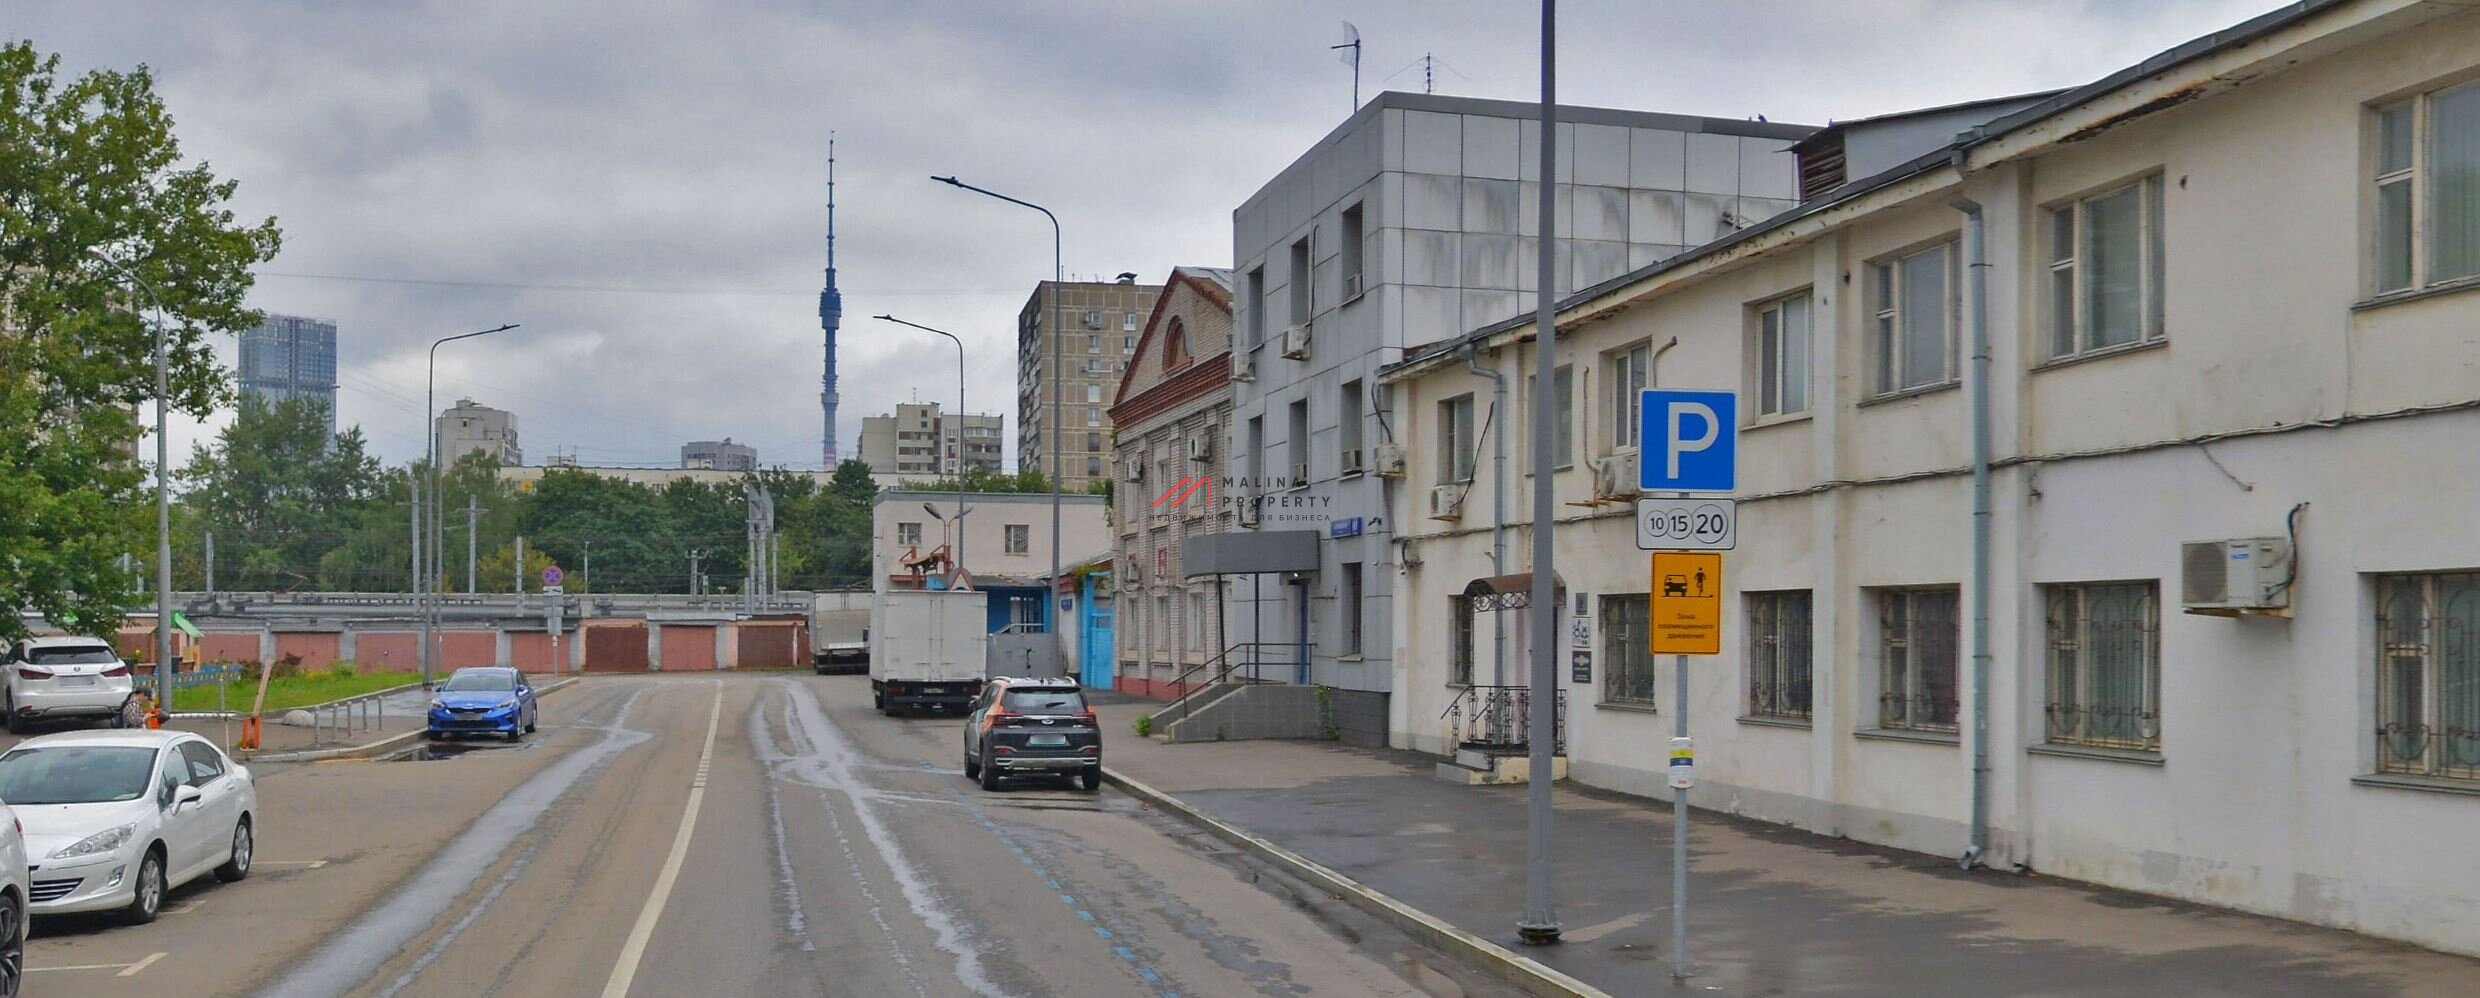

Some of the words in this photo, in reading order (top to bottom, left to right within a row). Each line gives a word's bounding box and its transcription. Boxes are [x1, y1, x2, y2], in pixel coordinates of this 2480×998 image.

[1667, 401, 1720, 479] P
[1650, 517, 1664, 530] 10
[1670, 515, 1688, 532] 15
[1696, 513, 1724, 534] 20
